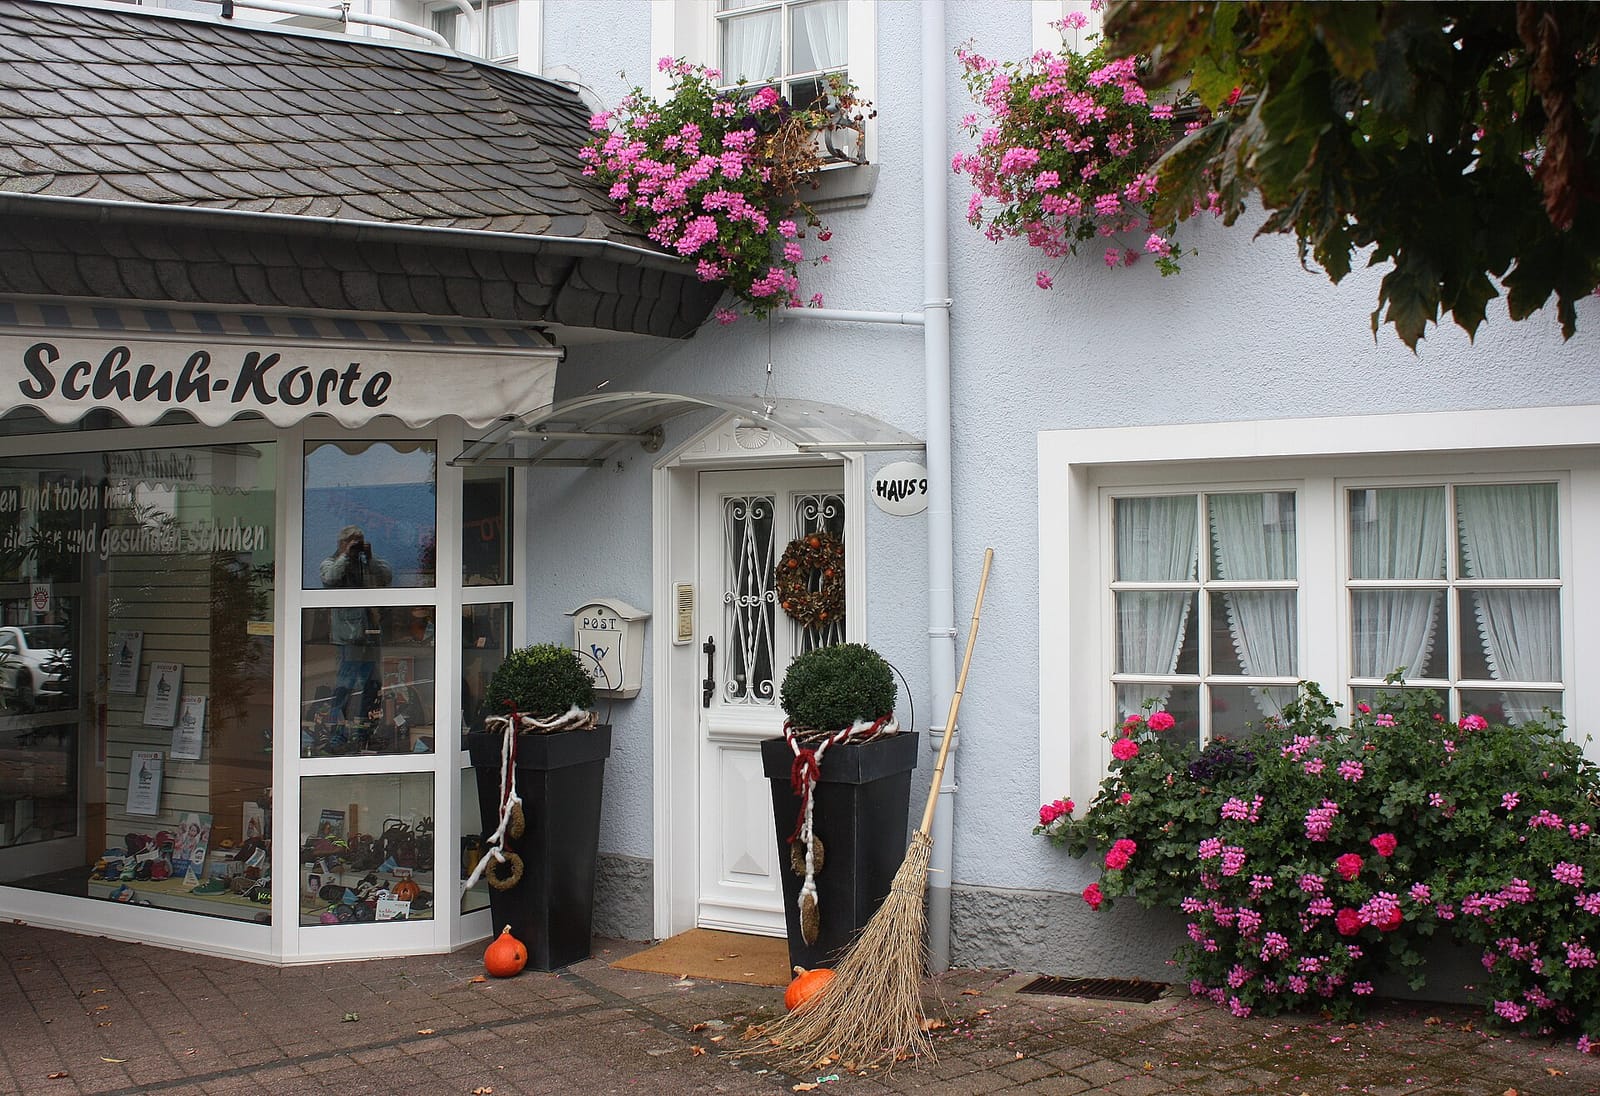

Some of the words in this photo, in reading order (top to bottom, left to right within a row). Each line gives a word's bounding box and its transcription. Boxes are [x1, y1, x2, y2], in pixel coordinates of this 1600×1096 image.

[18, 343, 392, 407] Schuh-Korte
[20, 481, 50, 512] und
[54, 480, 98, 511] toben
[876, 479, 918, 503] HAUS
[918, 478, 928, 495] 9
[66, 523, 96, 553] und
[99, 522, 182, 560] gesunden
[583, 617, 617, 630] POST
